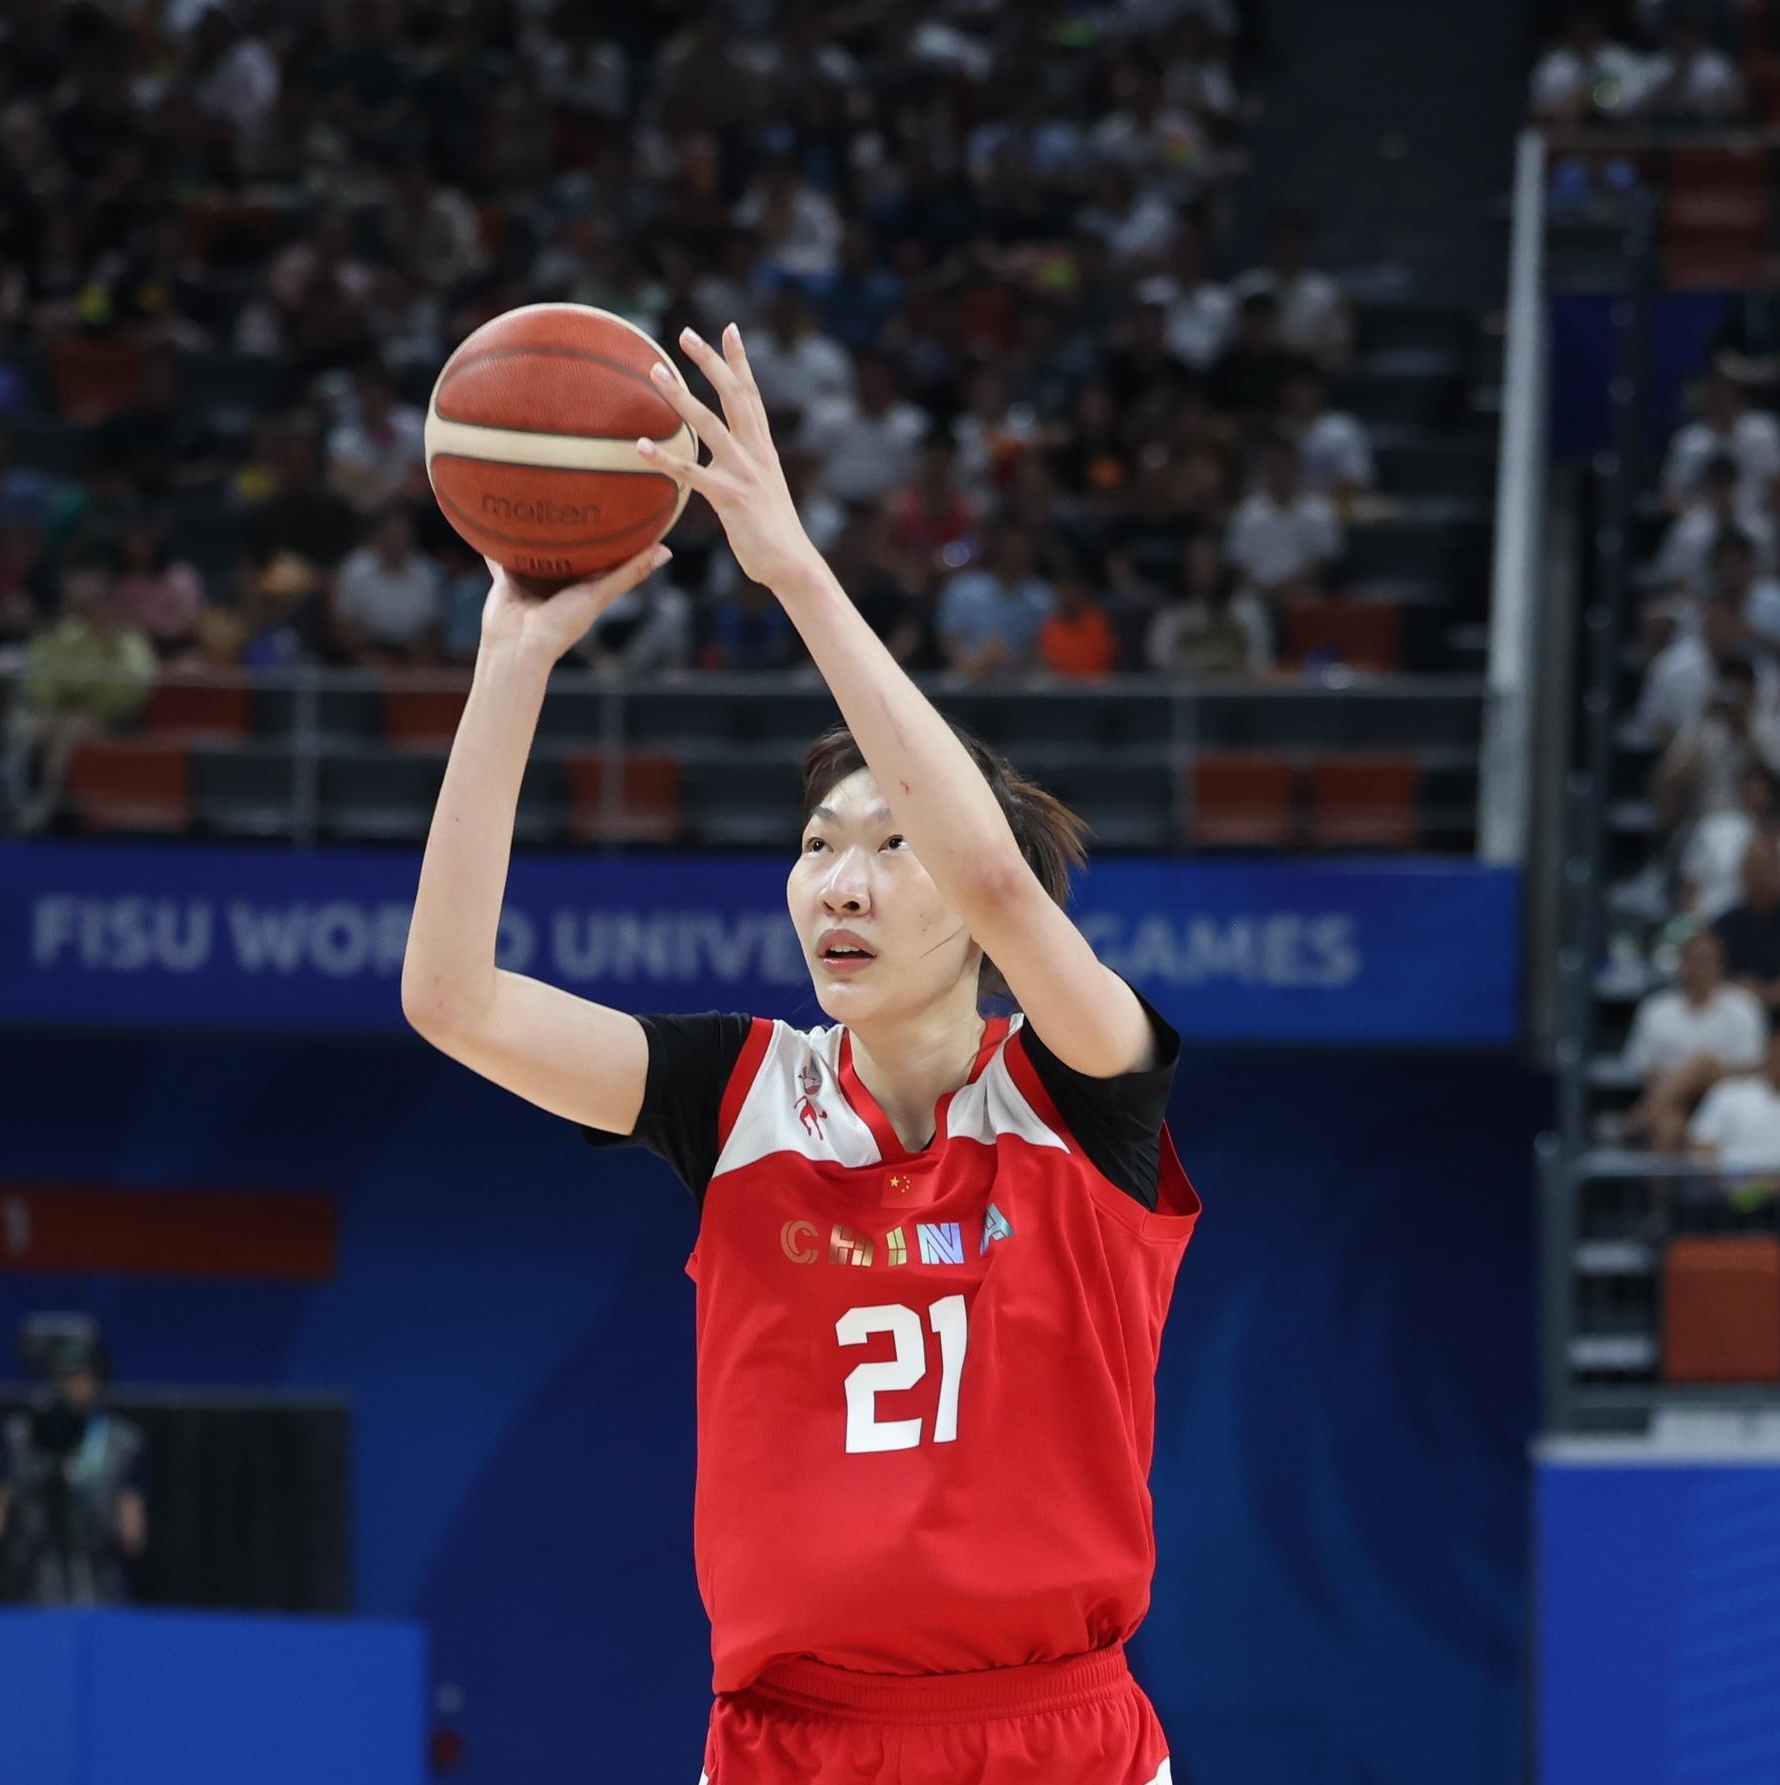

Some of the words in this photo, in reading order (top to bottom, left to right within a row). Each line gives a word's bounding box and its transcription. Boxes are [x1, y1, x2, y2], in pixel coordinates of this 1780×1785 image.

[481, 493, 601, 525] molten
[32, 896, 214, 971] FISU
[227, 897, 533, 979] WORD
[1077, 911, 1359, 985] GAMES
[780, 1202, 1014, 1267] CHINA
[834, 1294, 969, 1454] 21
